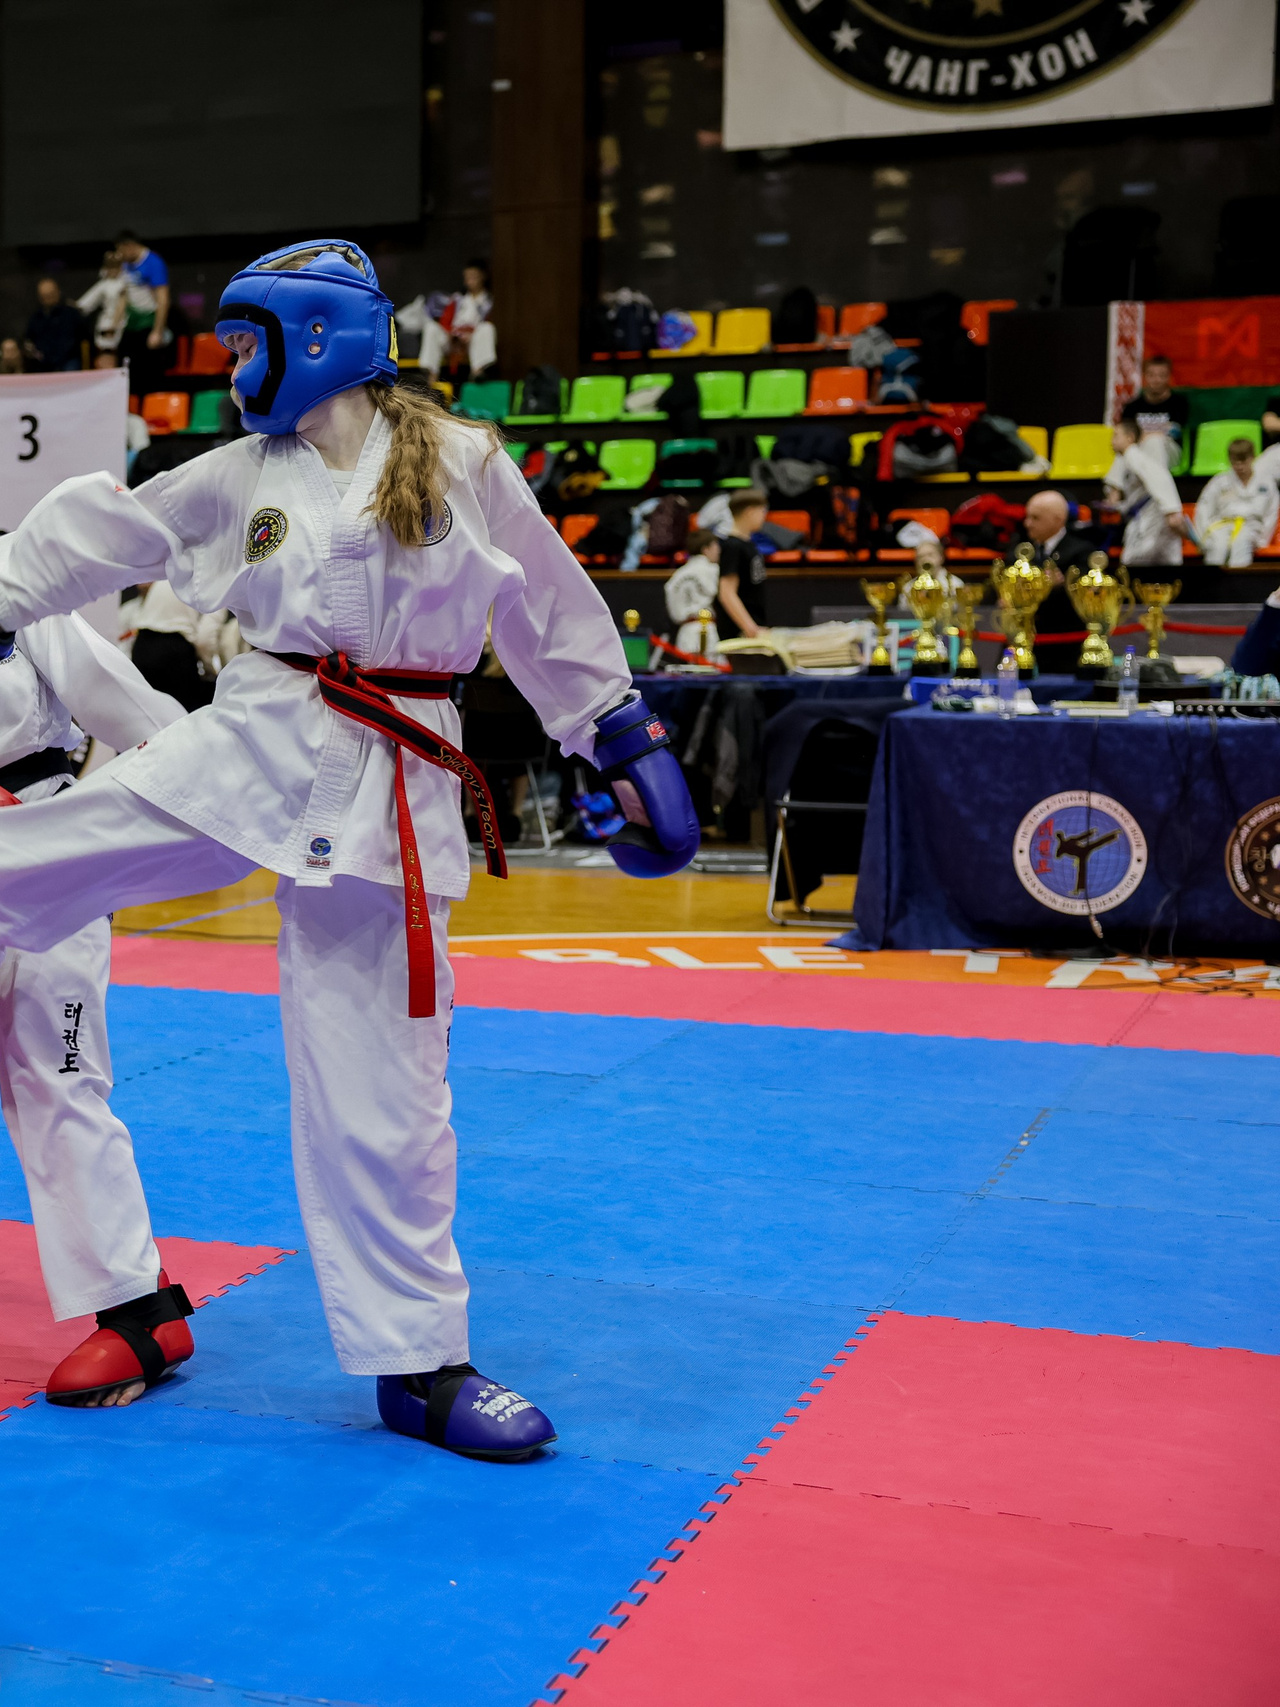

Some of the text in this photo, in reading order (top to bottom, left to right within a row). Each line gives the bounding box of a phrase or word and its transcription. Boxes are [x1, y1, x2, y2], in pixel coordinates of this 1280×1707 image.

[883, 28, 1099, 96] ЧАНГ-ХОН
[18, 414, 39, 461] 3
[433, 745, 497, 850] Sakibov's Team
[58, 1002, 83, 1073] 태권도
